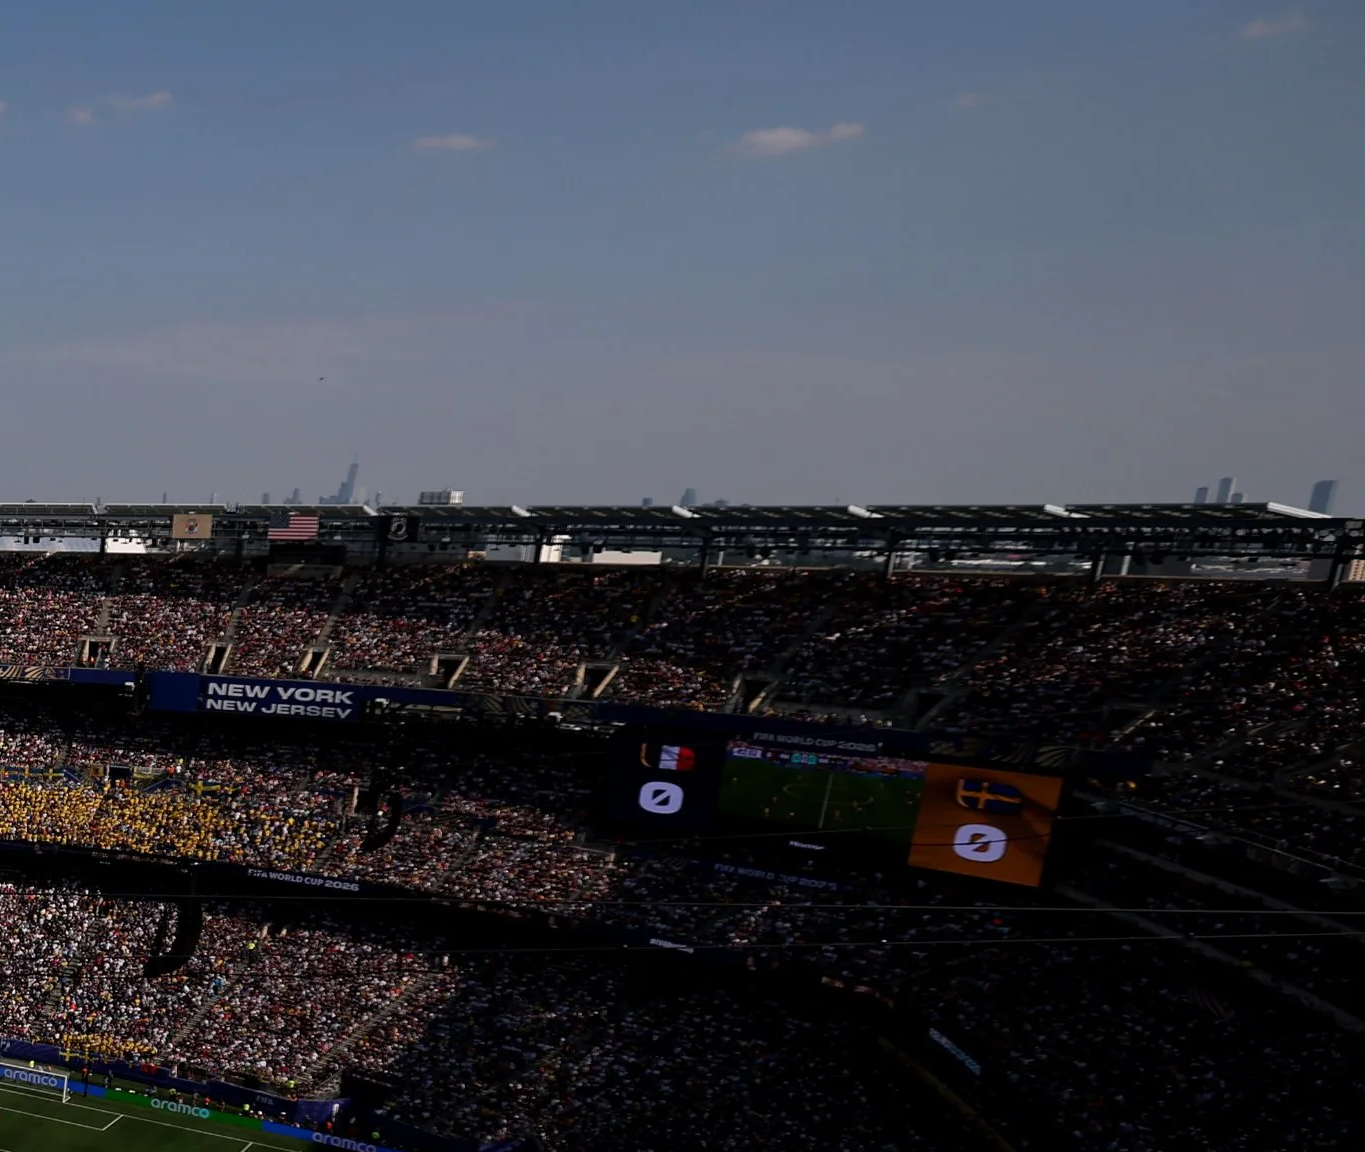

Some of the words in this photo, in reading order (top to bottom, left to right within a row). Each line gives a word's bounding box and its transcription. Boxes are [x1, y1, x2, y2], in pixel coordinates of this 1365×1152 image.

[208, 682, 270, 699] NEW
[276, 687, 355, 705] YORK
[206, 698, 257, 713] NEW
[261, 703, 352, 719] JERSEY
[247, 868, 269, 879] FIFA
[269, 872, 303, 883] WORLD
[304, 876, 324, 886] CUP
[324, 879, 360, 892] 2026
[4, 1068, 57, 1087] aramco
[150, 1098, 210, 1119] aramco
